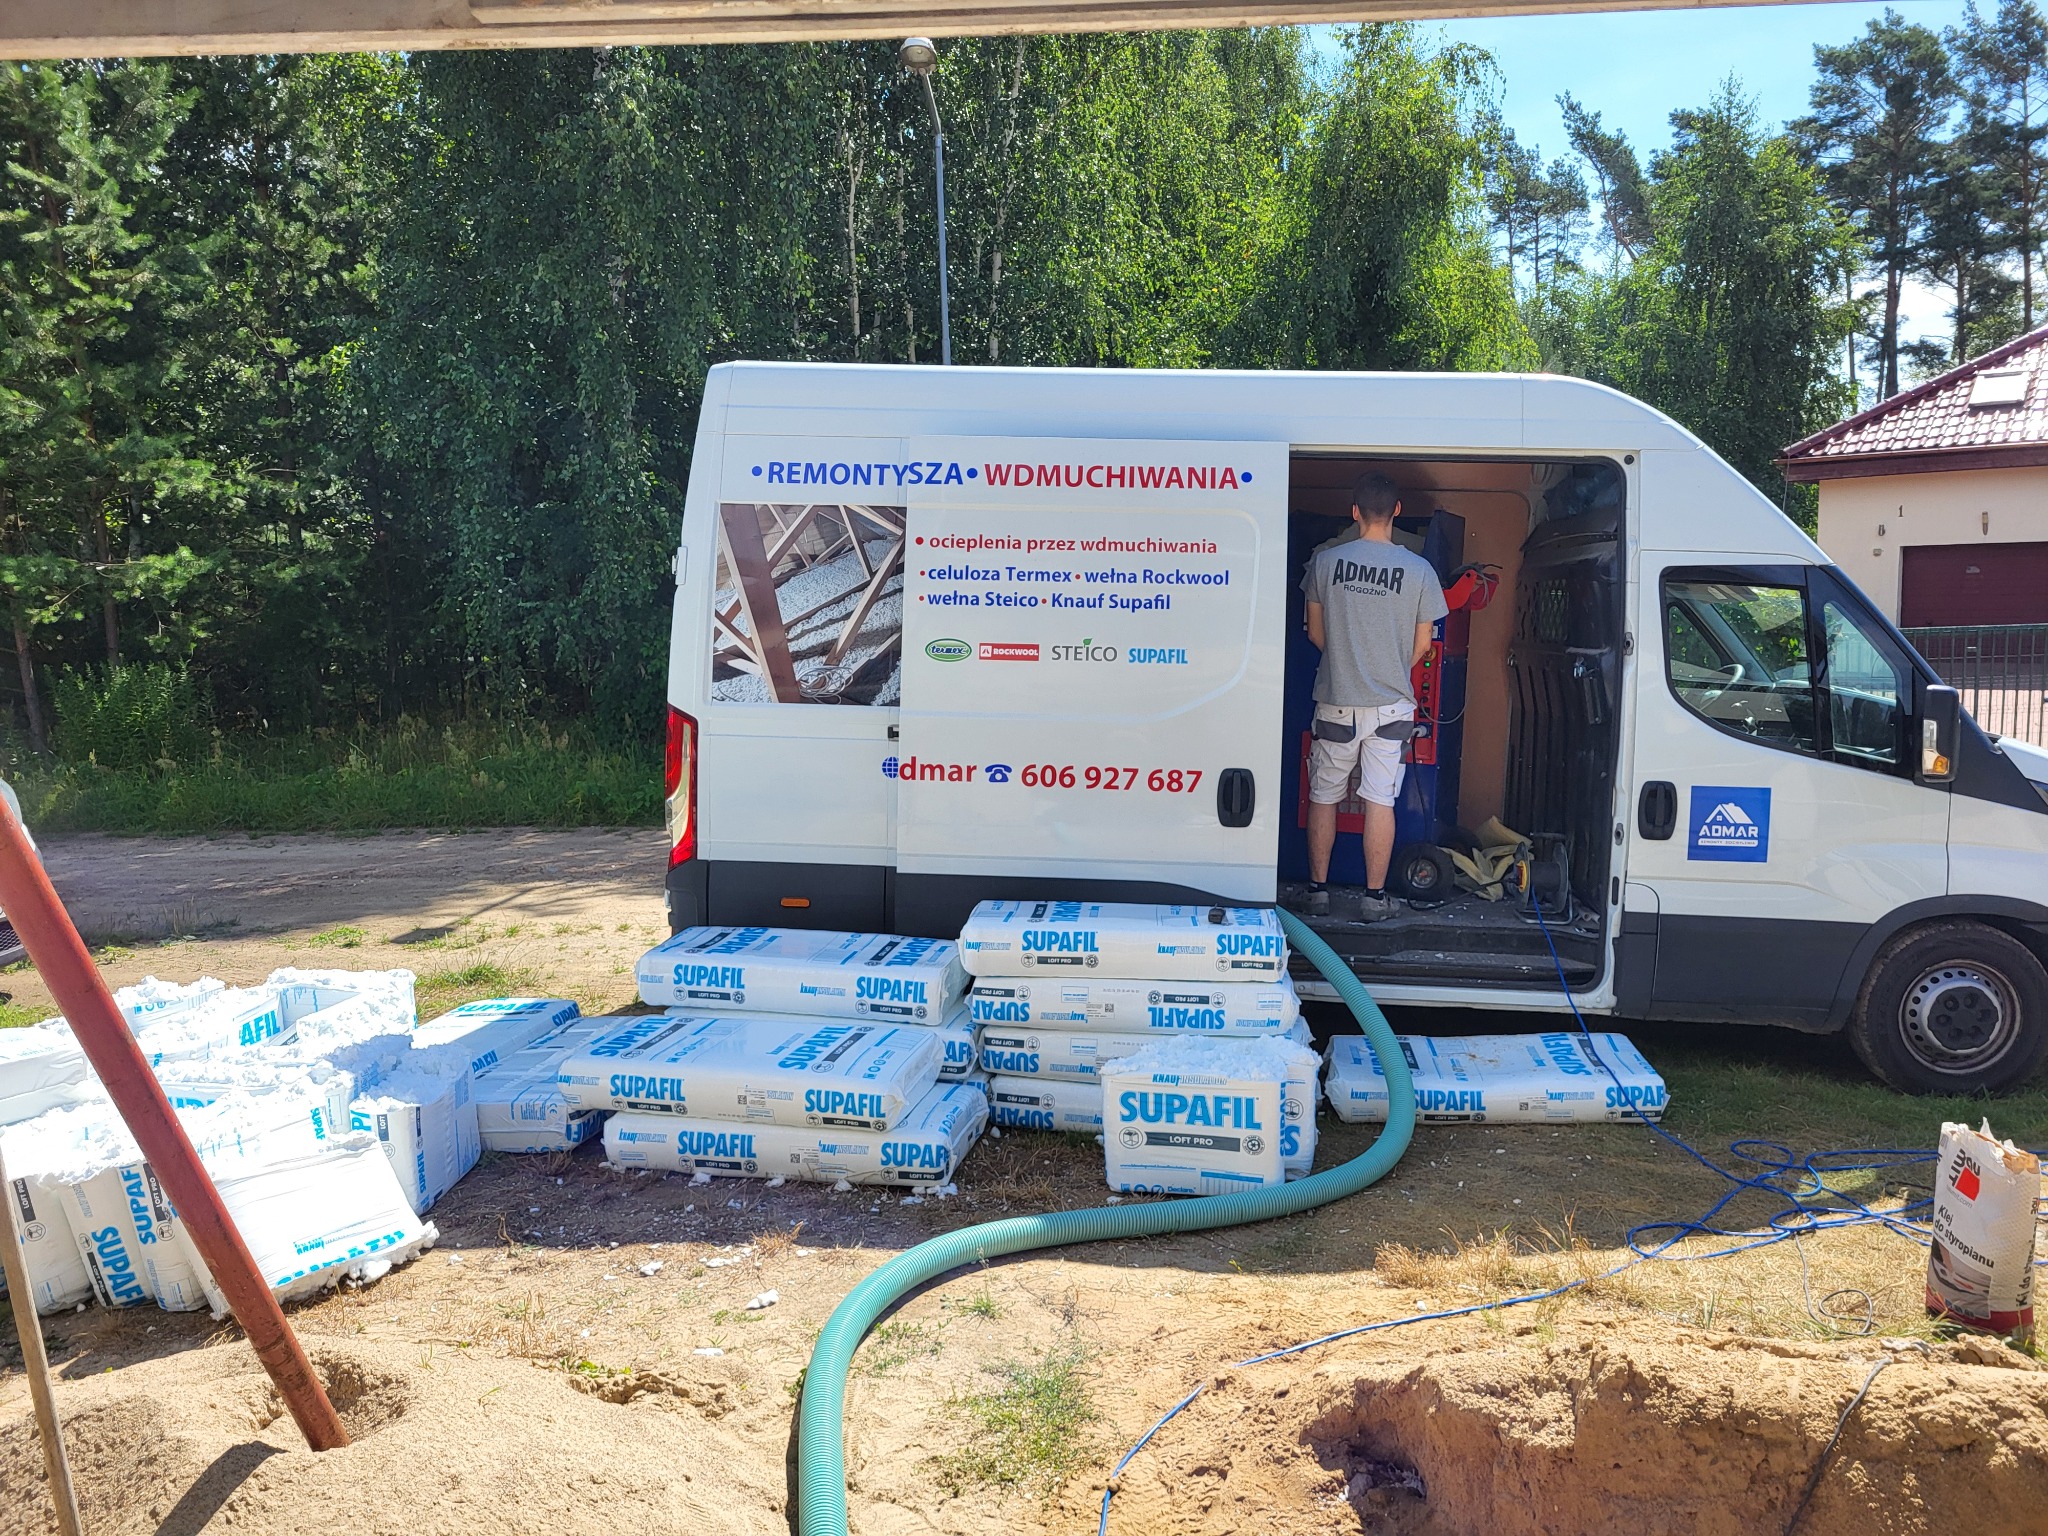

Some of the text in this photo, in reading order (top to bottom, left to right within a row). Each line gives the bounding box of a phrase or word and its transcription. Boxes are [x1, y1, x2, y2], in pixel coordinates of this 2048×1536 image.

[984, 463, 1239, 490] WDMUCHIWANIA
[929, 533, 1217, 554] ocieplenia przez wdmuchiwania
[928, 564, 1229, 585] celuloza Termex wełna Rockwool
[1332, 558, 1405, 595] ADMAR
[927, 590, 1171, 613] wełna Steico Knauf Supafil
[992, 647, 1039, 656] ROCKWOOL
[1128, 647, 1189, 665] SUPAFIL
[898, 755, 1203, 793] dmar 606 927 687
[1698, 824, 1759, 838] ADMAR
[1021, 930, 1099, 953] SUPAFIL
[672, 963, 746, 990] SUPAFIL
[855, 975, 928, 1005] SUPAFIL
[240, 1010, 281, 1047] AFIL
[1148, 1006, 1226, 1030] SUPAFIL
[590, 1016, 676, 1057] SUPAFIL
[778, 1025, 855, 1071] SUPAFIL
[1539, 1033, 1593, 1076] SUPAFIL
[609, 1074, 686, 1102] SUPAFIL
[1152, 1073, 1181, 1087] KNAUF
[804, 1088, 886, 1118] SUPAFIL
[1119, 1090, 1263, 1131] SUPAFIL
[1414, 1088, 1487, 1111] SUPAFIL
[379, 1115, 387, 1130] LOFT
[618, 1128, 638, 1144] KNAUF
[677, 1130, 757, 1159] SUPAFIL
[1168, 1135, 1214, 1146] LOFT PRO
[150, 1176, 160, 1192] PRO
[416, 1151, 427, 1194] SUPAFIL
[15, 1179, 26, 1194] PRO
[1938, 1204, 1954, 1227] Klej
[1934, 1218, 1944, 1232] do
[1945, 1228, 1995, 1269] styropianu
